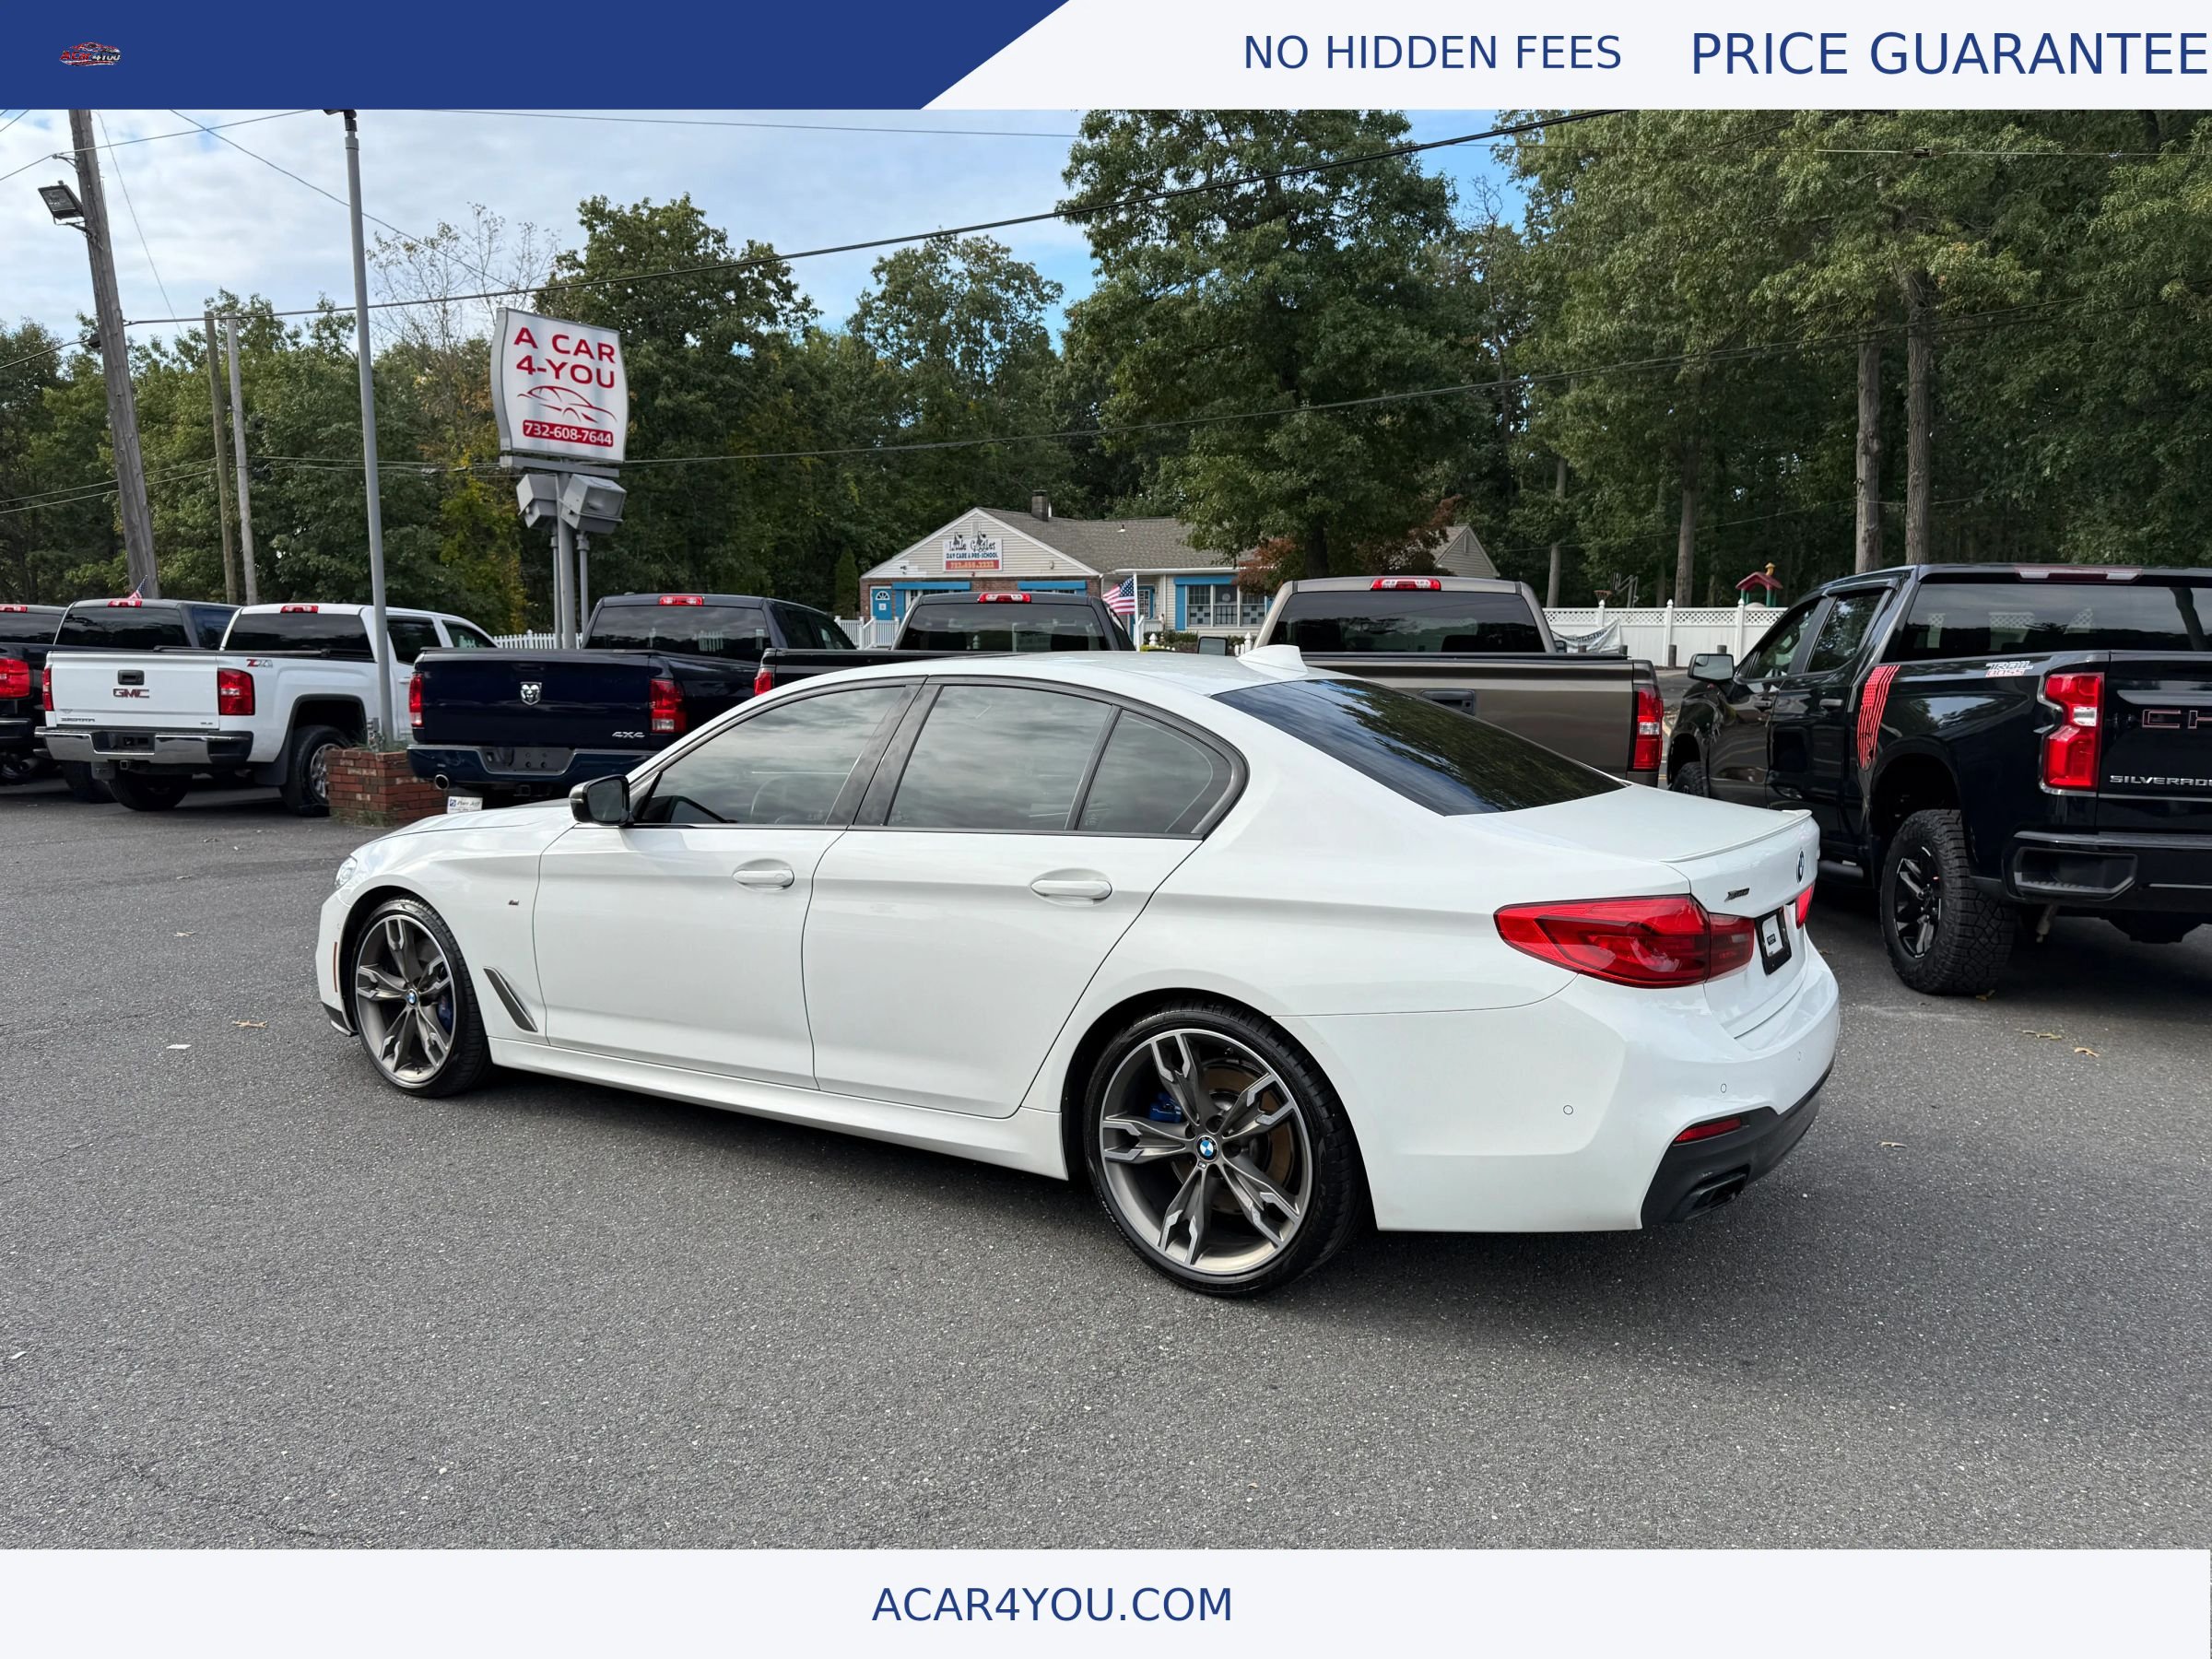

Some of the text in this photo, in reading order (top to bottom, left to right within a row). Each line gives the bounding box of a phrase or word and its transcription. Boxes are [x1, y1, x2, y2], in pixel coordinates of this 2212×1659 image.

[513, 326, 616, 364] A CAR
[516, 354, 615, 389] 4-YOU
[524, 421, 613, 445] 732-608-7644
[1985, 660, 2034, 670] TRAIL
[1985, 668, 2026, 677] BOSS
[112, 688, 150, 699] GMC
[2109, 774, 2212, 786] SILVERAD
